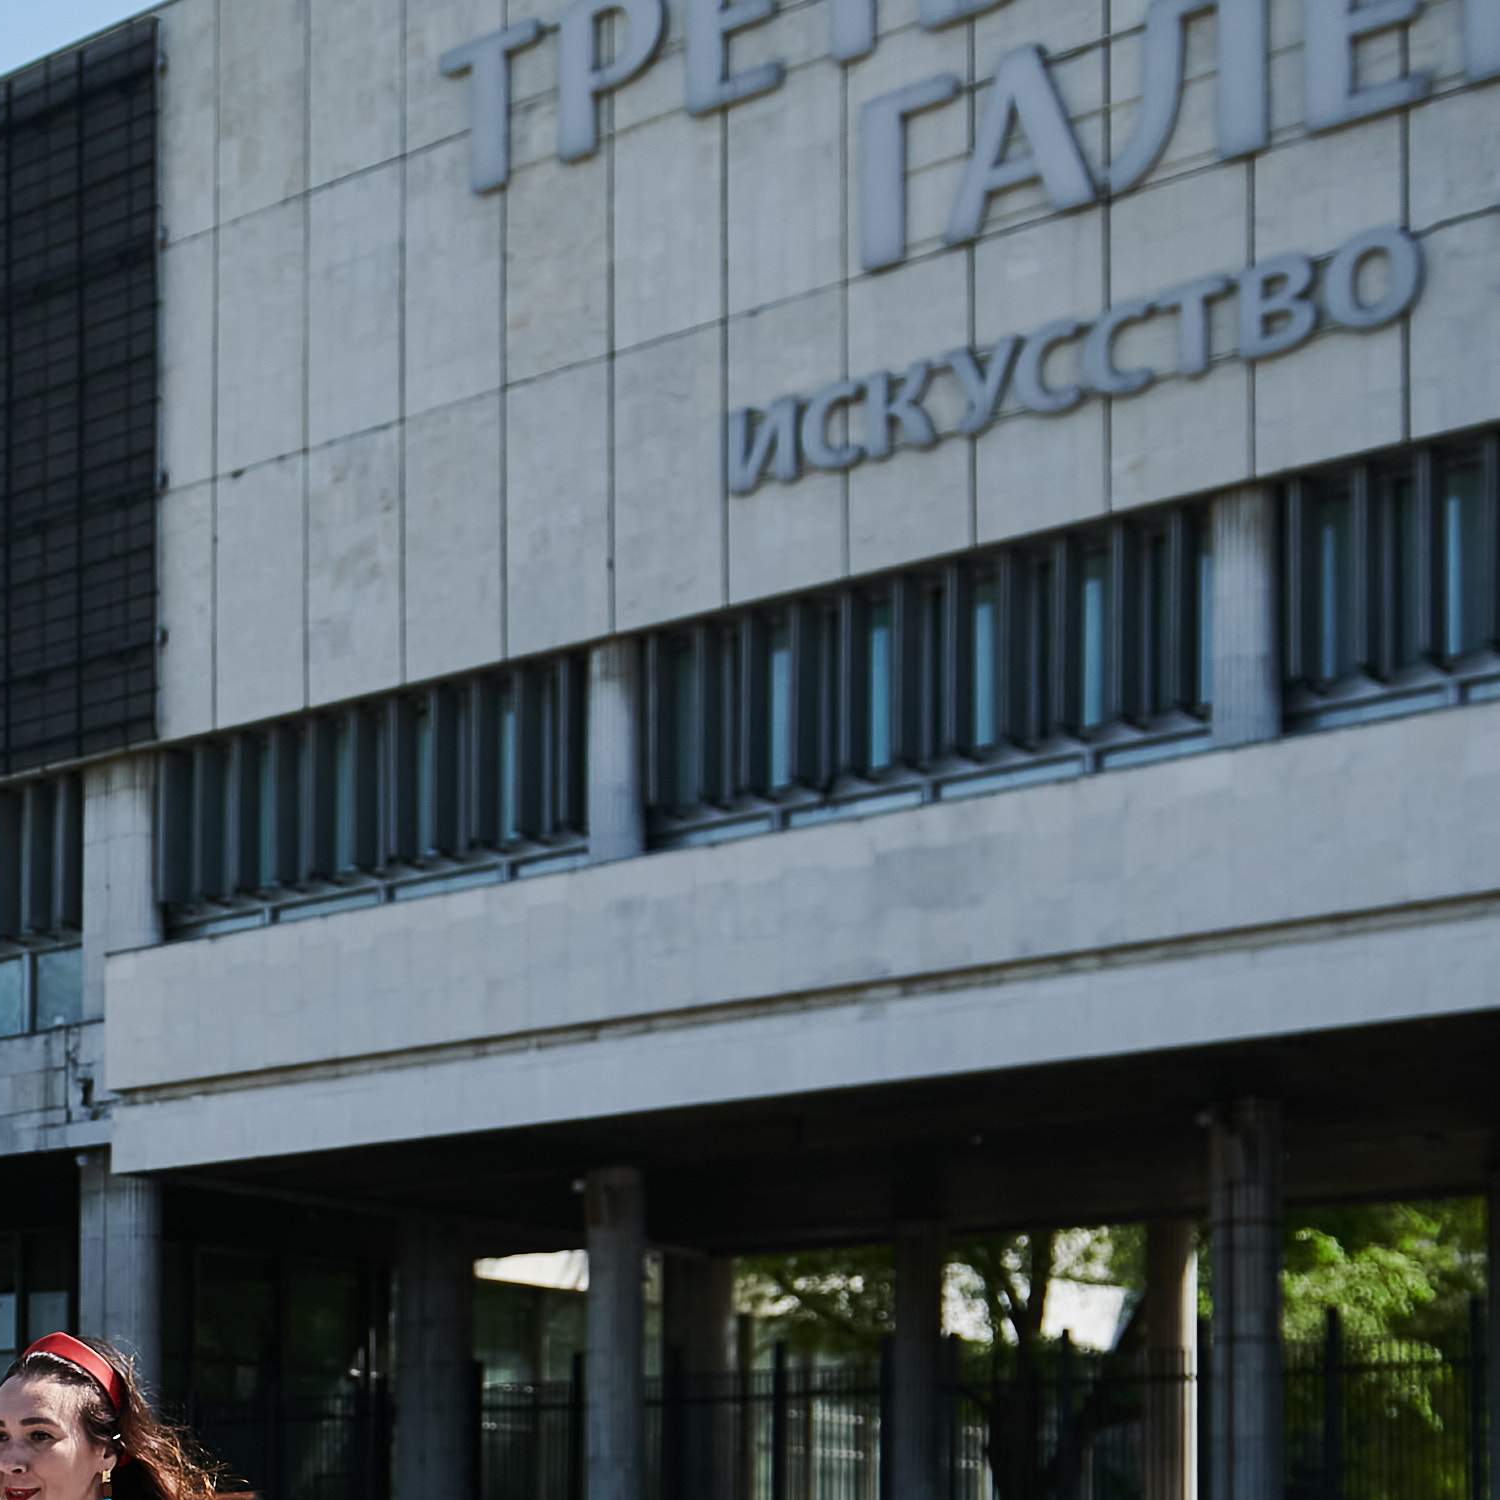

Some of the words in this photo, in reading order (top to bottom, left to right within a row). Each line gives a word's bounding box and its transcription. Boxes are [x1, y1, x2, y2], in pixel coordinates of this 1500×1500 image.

[439, 0, 1010, 195] ТРЕ
[859, 0, 1500, 274] ГАЛЕ
[727, 224, 1426, 498] ИСКУССТВО
